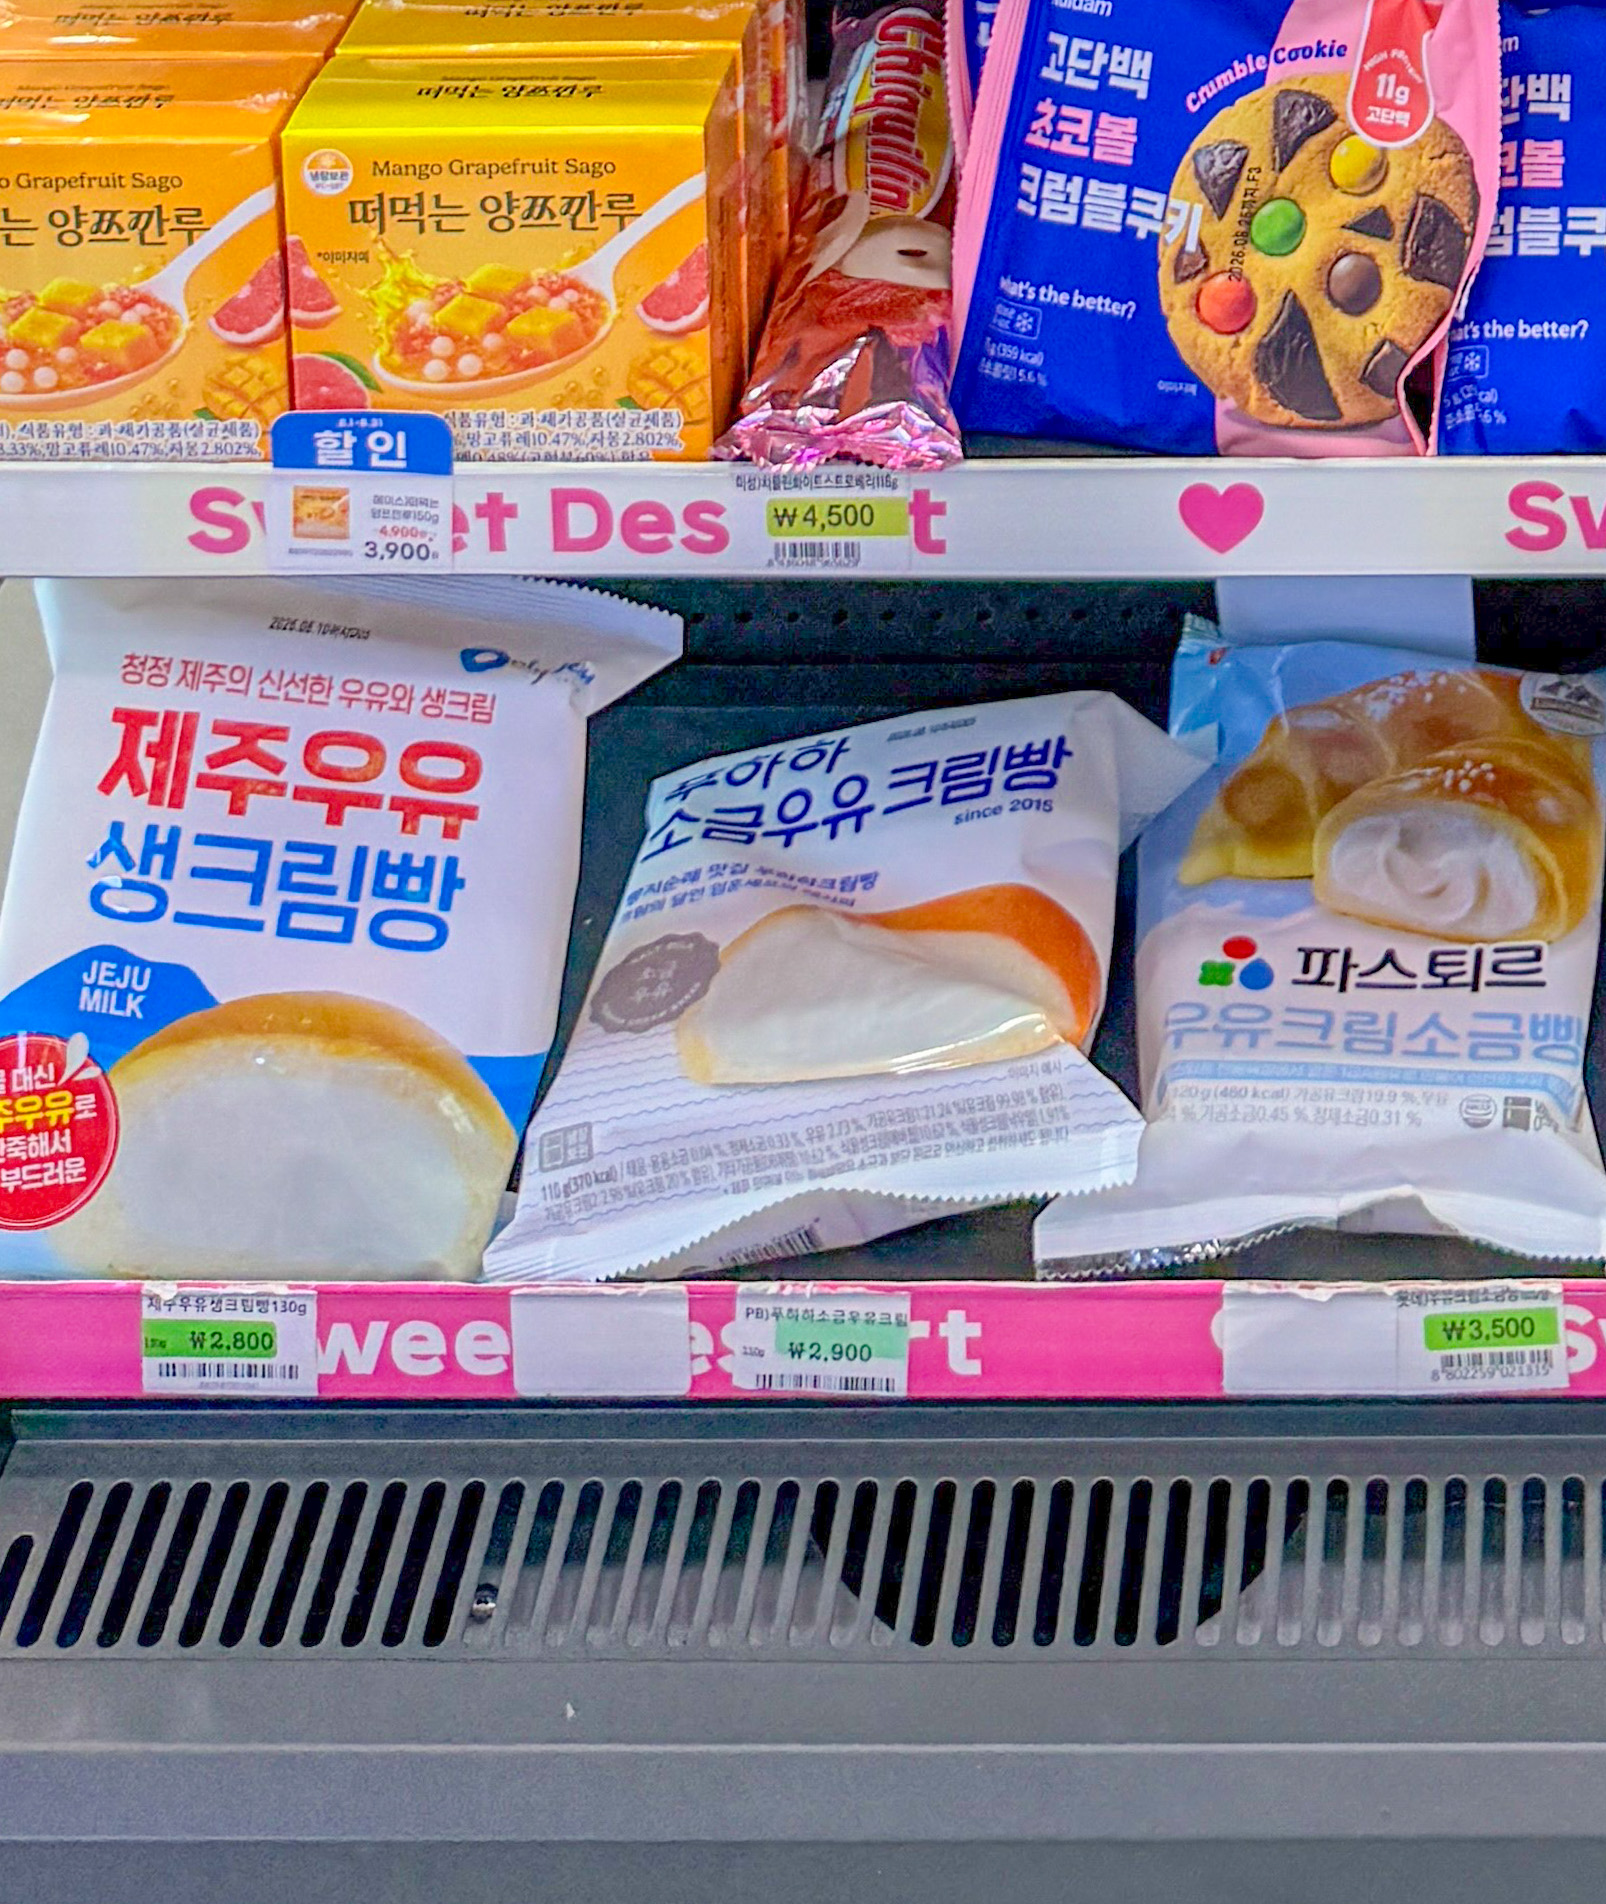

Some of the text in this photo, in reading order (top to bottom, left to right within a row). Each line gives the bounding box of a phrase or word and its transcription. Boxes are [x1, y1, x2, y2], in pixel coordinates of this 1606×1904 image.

[1039, 31, 1153, 100] 고단백
[1185, 40, 1348, 113] Crumble Cookie
[1375, 74, 1409, 105] 11g
[1025, 97, 1139, 166] 초코볼
[372, 156, 617, 180] Mango Grapefruit Sago
[348, 194, 471, 233] 떠먹는
[1016, 164, 1203, 254] 크럼블쿠키
[121, 652, 497, 724] 청정 제주의 신선한 우유와 생크림
[97, 705, 485, 840] 제주우유
[640, 736, 1074, 864] 소금우유 크림빵
[953, 804, 1004, 827] since
[87, 819, 466, 952] 생크림빵
[78, 987, 144, 1019] MILK
[82, 961, 152, 993] JEJU
[1292, 944, 1548, 994] 파스퇴르
